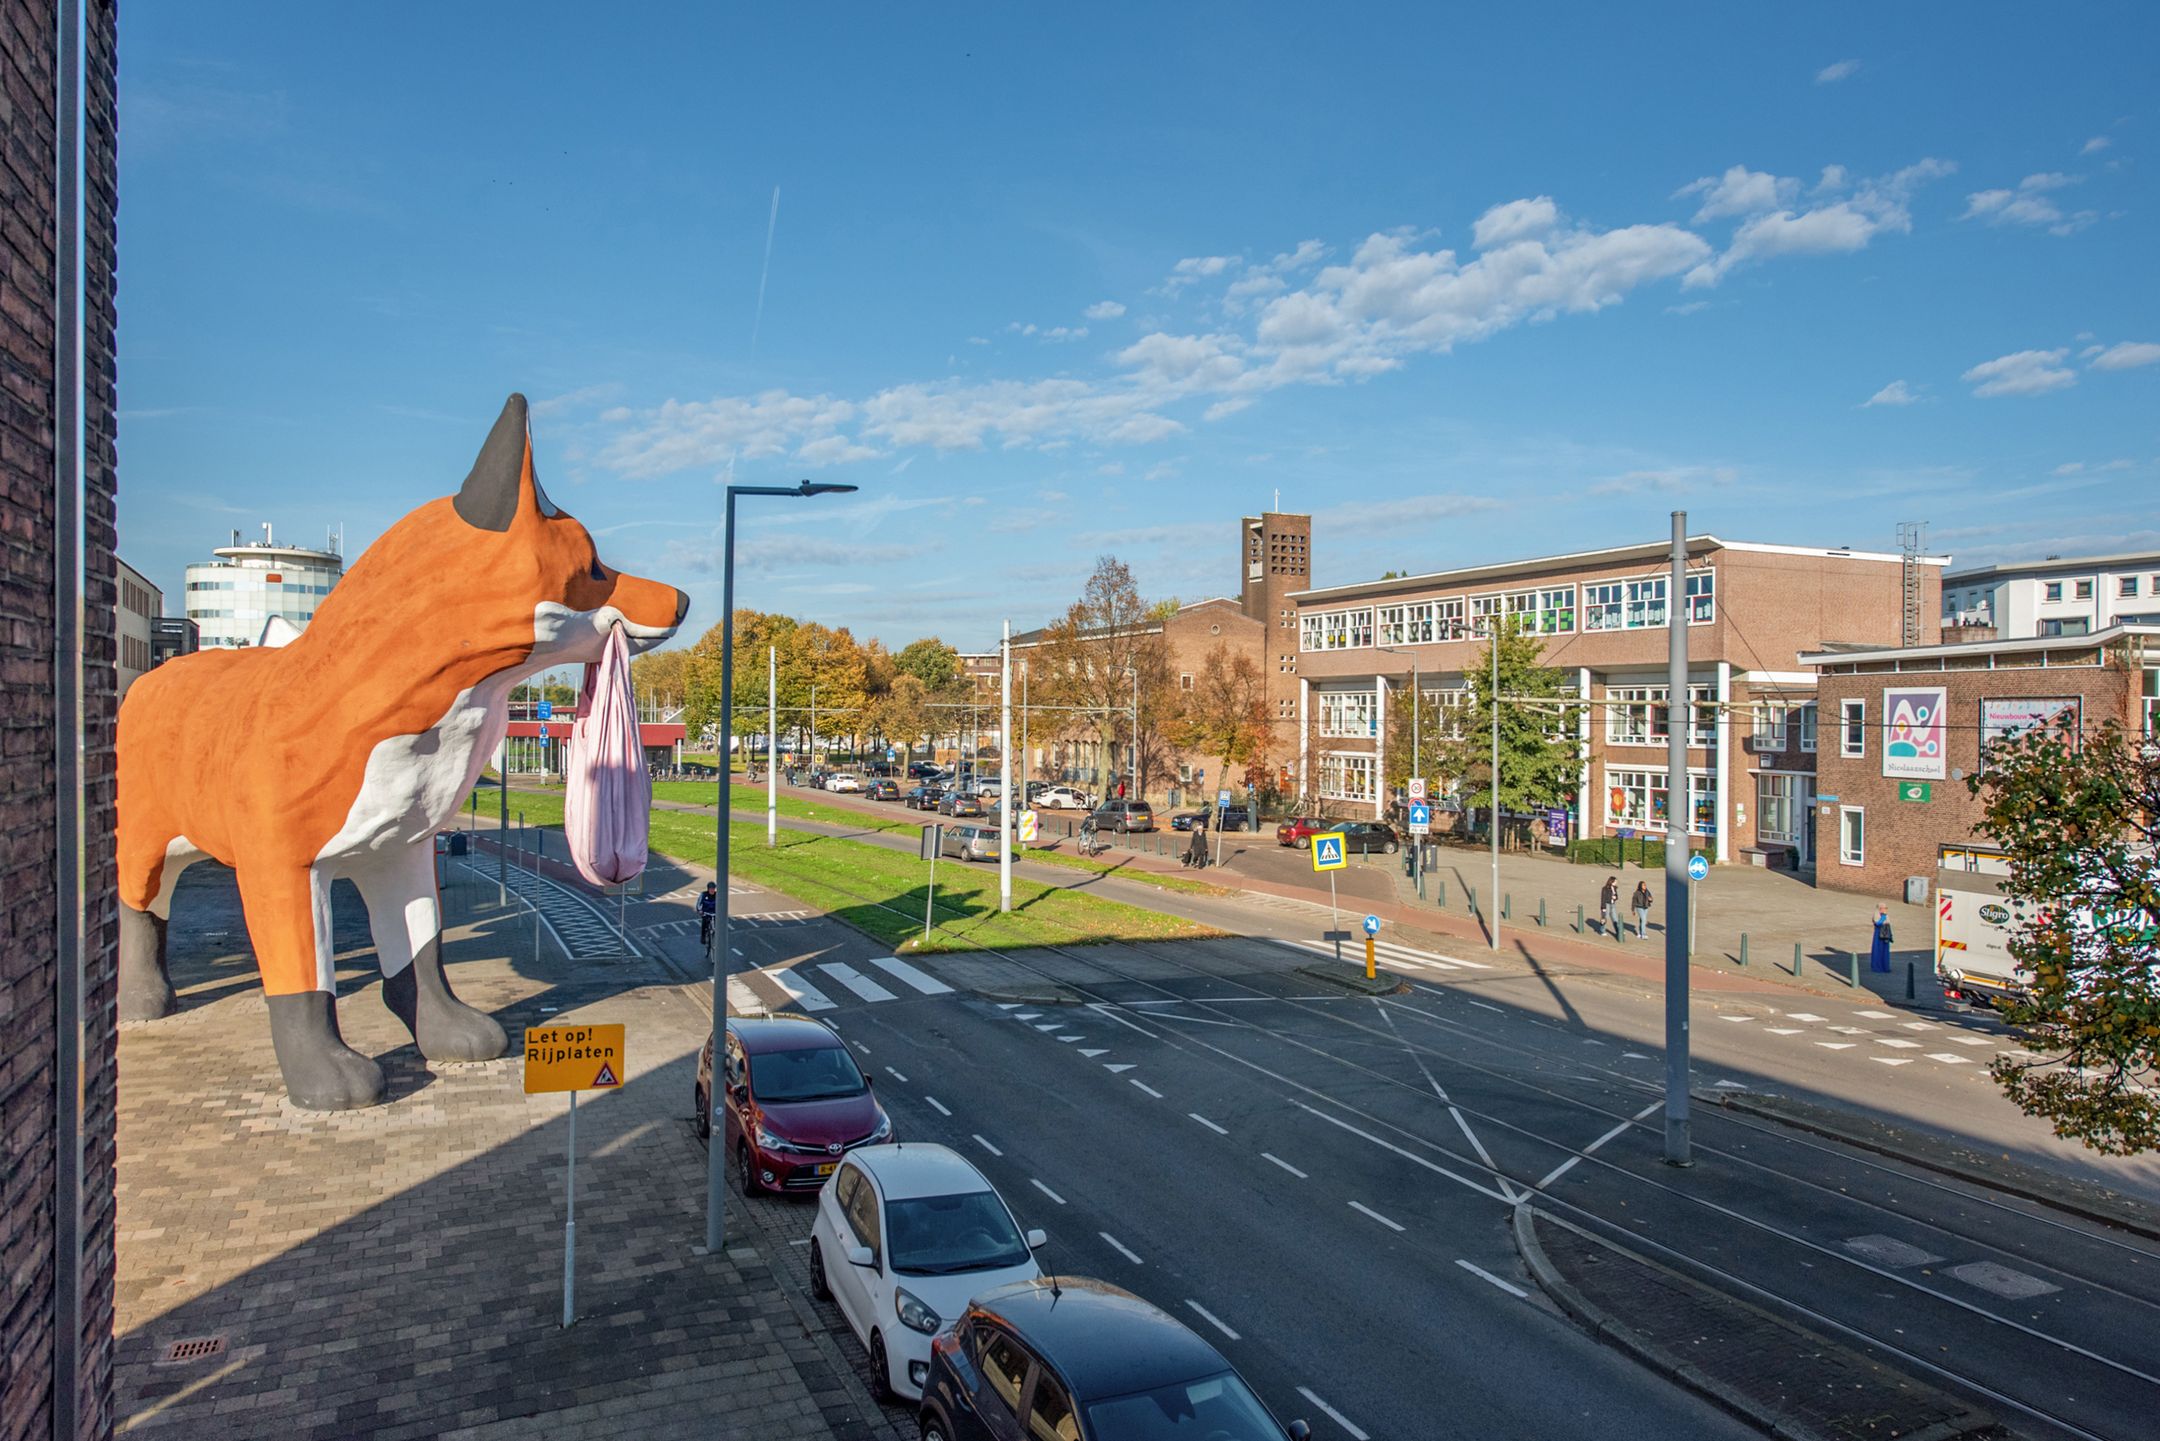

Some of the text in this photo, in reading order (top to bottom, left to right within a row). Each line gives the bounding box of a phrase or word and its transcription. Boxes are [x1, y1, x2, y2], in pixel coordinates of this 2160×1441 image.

[1887, 763, 1941, 773] Nicolaasschool
[1981, 907, 2009, 920] Sligro
[528, 1028, 592, 1044] Let op!
[528, 1046, 613, 1064] Rijplaten
